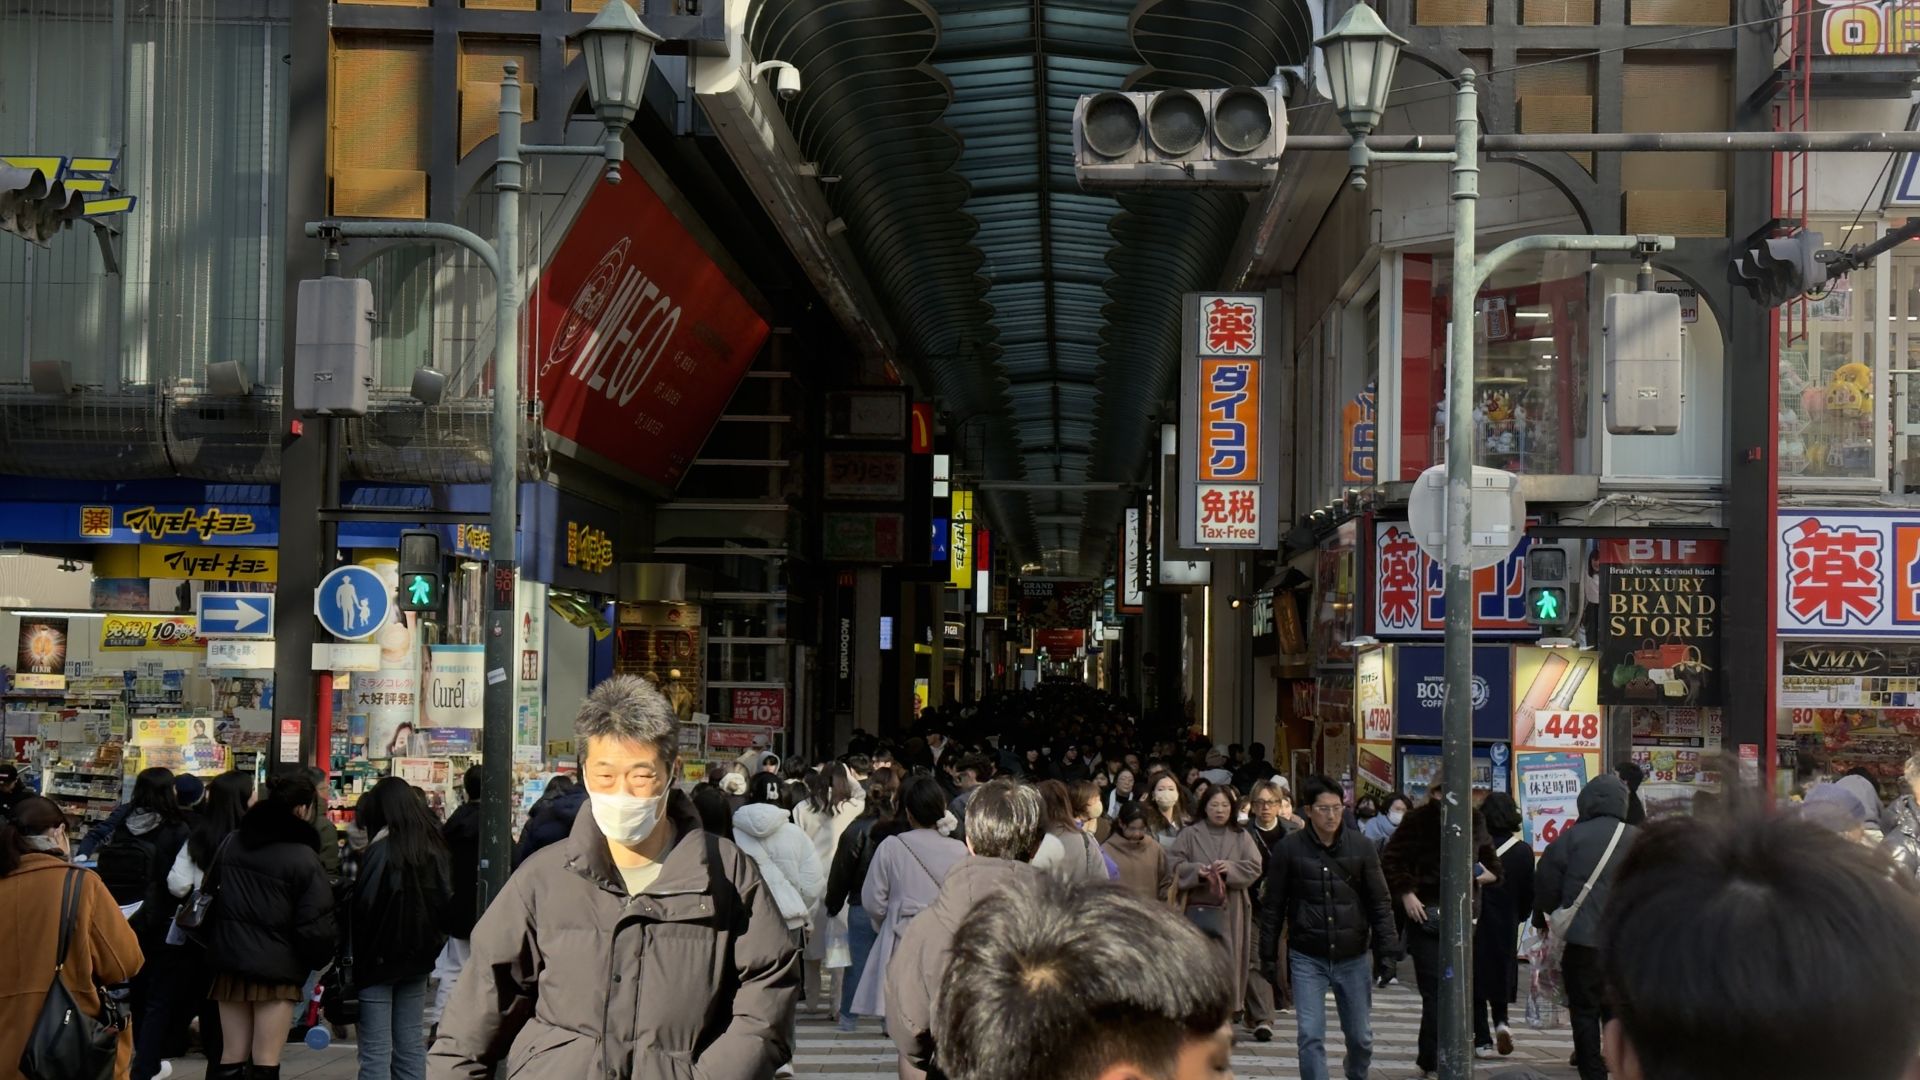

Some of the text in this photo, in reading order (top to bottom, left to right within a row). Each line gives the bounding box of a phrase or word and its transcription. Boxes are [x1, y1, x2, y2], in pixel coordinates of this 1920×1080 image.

[570, 264, 682, 407] WEGO
[1208, 299, 1254, 352] 薬
[1211, 365, 1250, 477] ダイコク
[1201, 488, 1256, 524] 免税
[84, 509, 109, 534] 薬
[124, 507, 255, 539] マツモトキヨシ
[1201, 524, 1256, 540] Tax-Free
[164, 550, 269, 578] マツモトキヨシ
[1610, 566, 1715, 576] Brand New & Second hand
[1785, 517, 1879, 621] 薬
[1381, 526, 1419, 628] 薬
[1620, 577, 1705, 592] LUXURY
[1609, 594, 1716, 615] BRAND
[1610, 616, 1714, 637] STORE
[840, 618, 849, 679] McDonald's
[1799, 649, 1870, 668] NMN
[432, 678, 465, 709] Curél
[742, 696, 777, 705] カラコン
[1416, 682, 1444, 699] BOS
[1421, 699, 1443, 708] COFF
[1530, 780, 1578, 796] 休足時間
